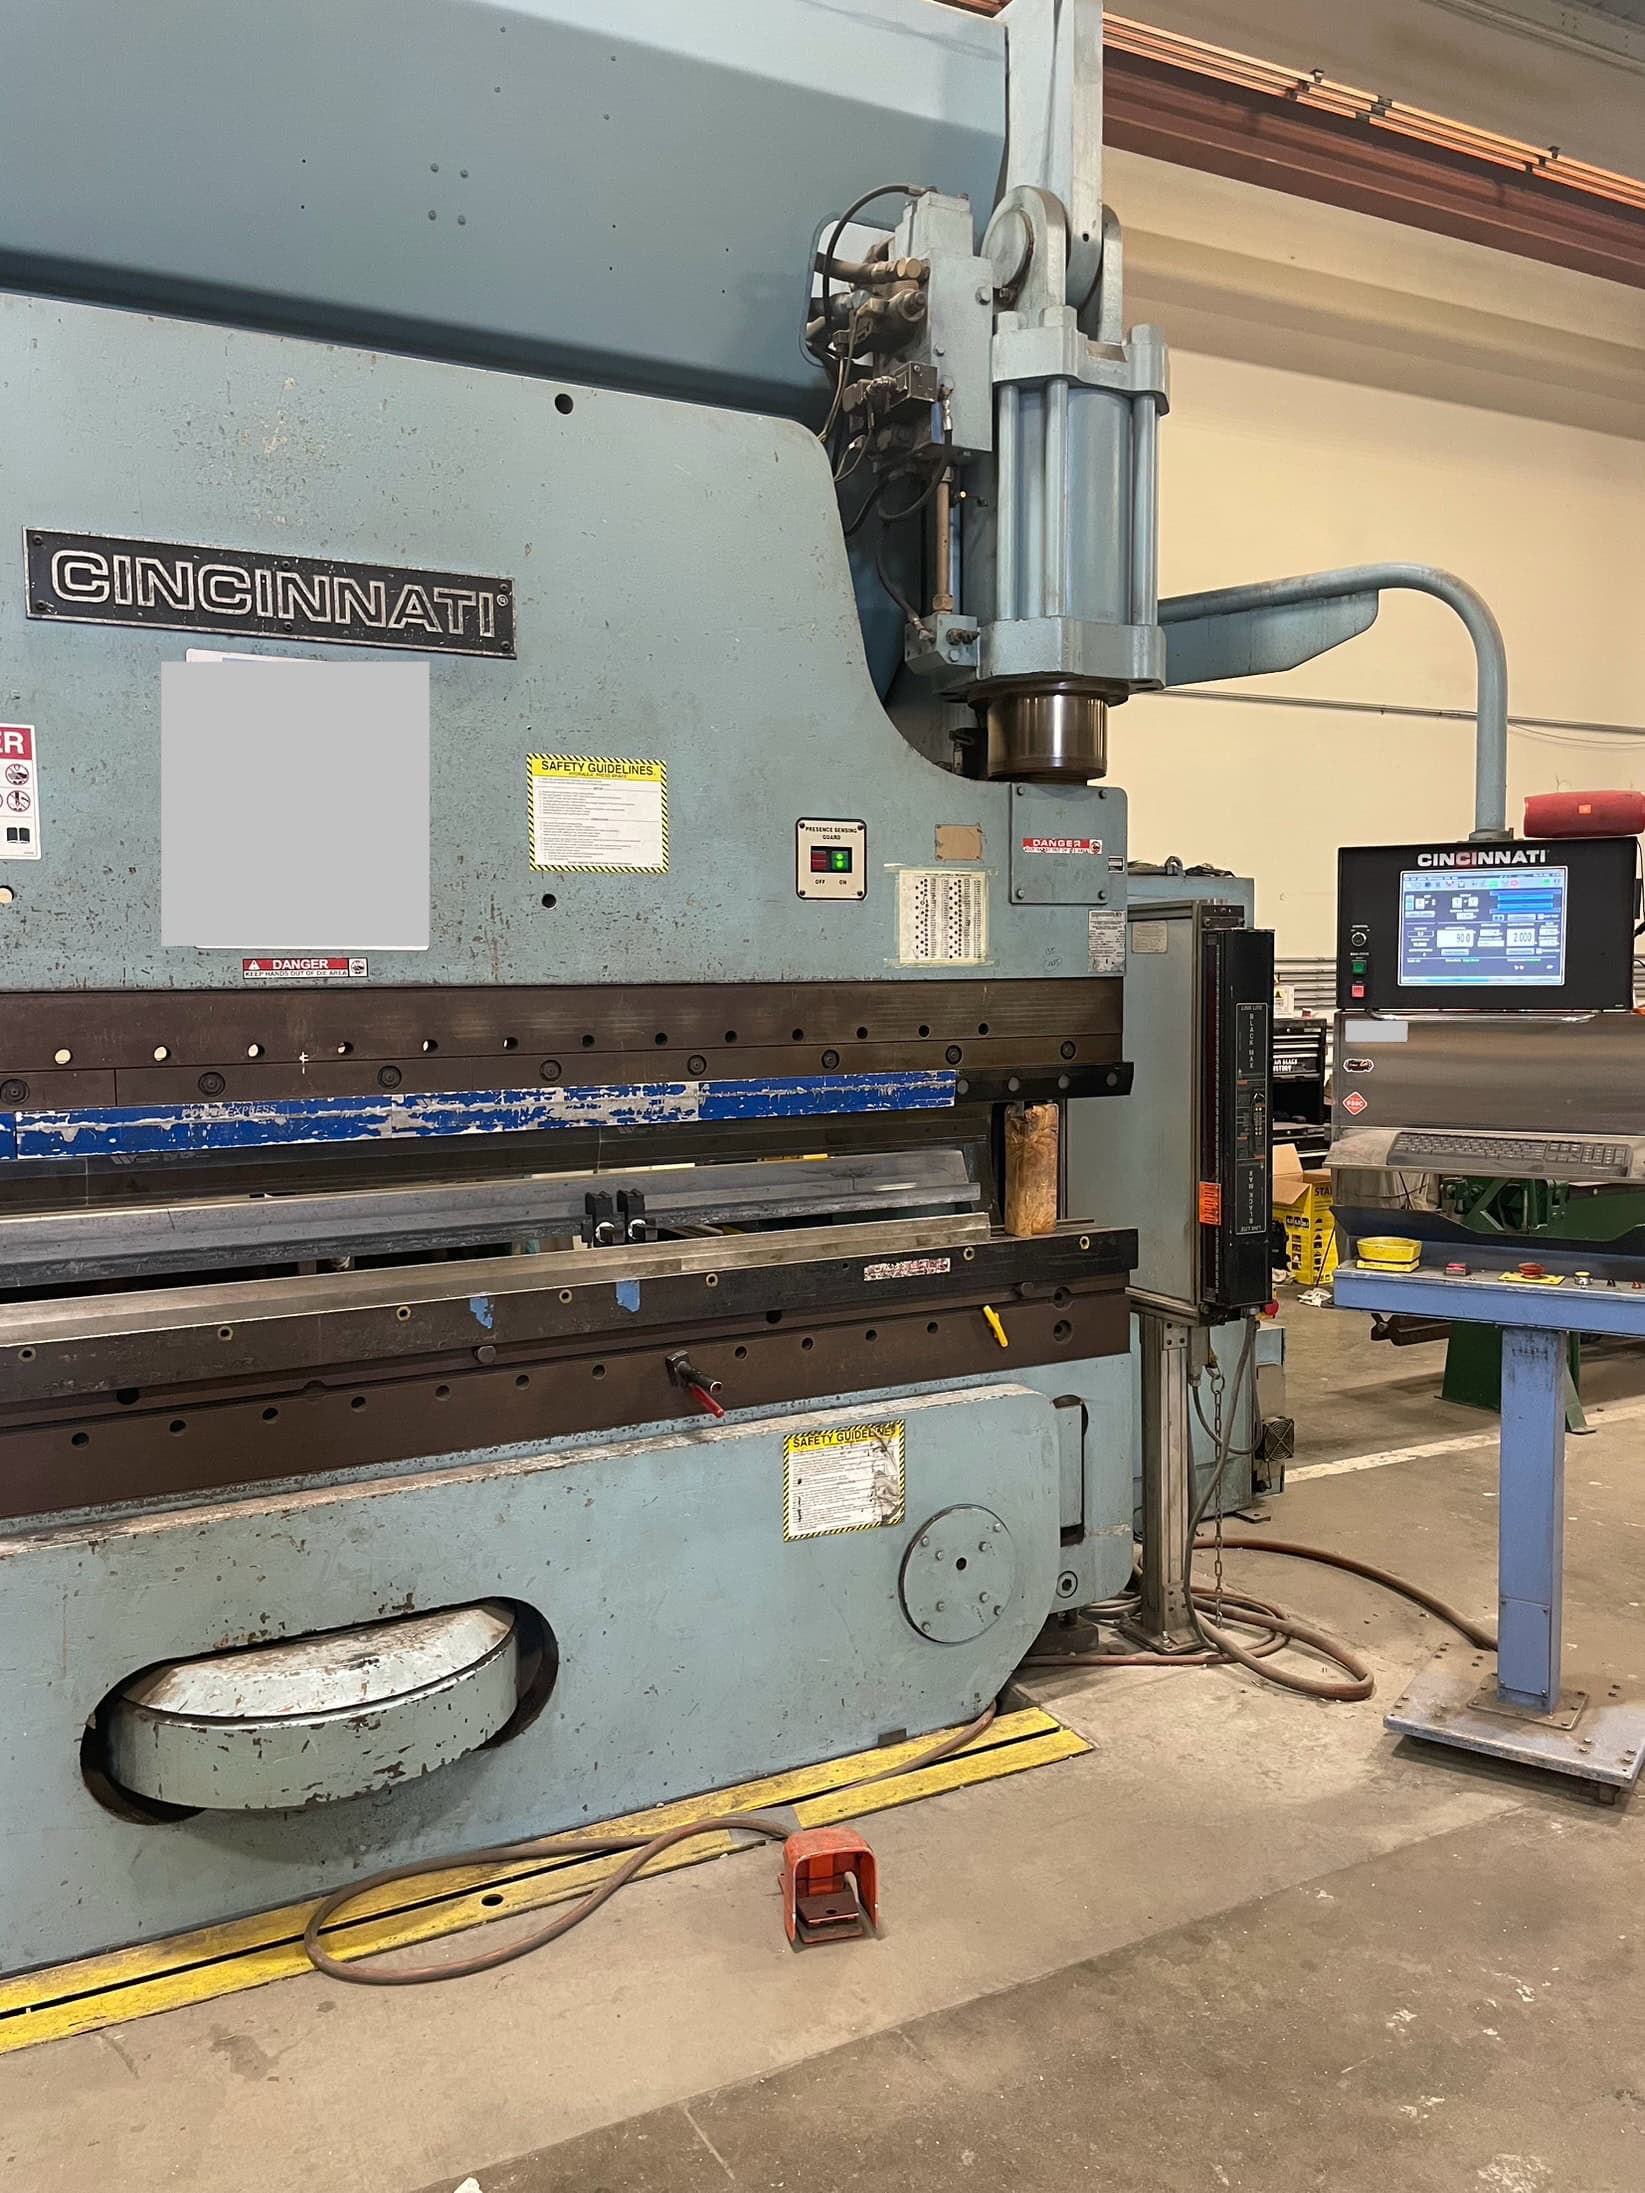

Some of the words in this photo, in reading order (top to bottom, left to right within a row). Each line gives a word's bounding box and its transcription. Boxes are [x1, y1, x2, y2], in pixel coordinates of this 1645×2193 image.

[51, 550, 495, 638] CINCINNATI
[0, 731, 24, 754] R
[541, 760, 585, 772] SAFETY
[587, 762, 654, 776] GUIDELINES
[1032, 839, 1081, 847] DANGER
[1417, 849, 1546, 867] CINCINNATI
[272, 959, 329, 970] DANGER
[227, 1104, 278, 1117] EXPRESS
[1314, 1187, 1332, 1197] STA
[793, 1434, 834, 1448] SAFETY
